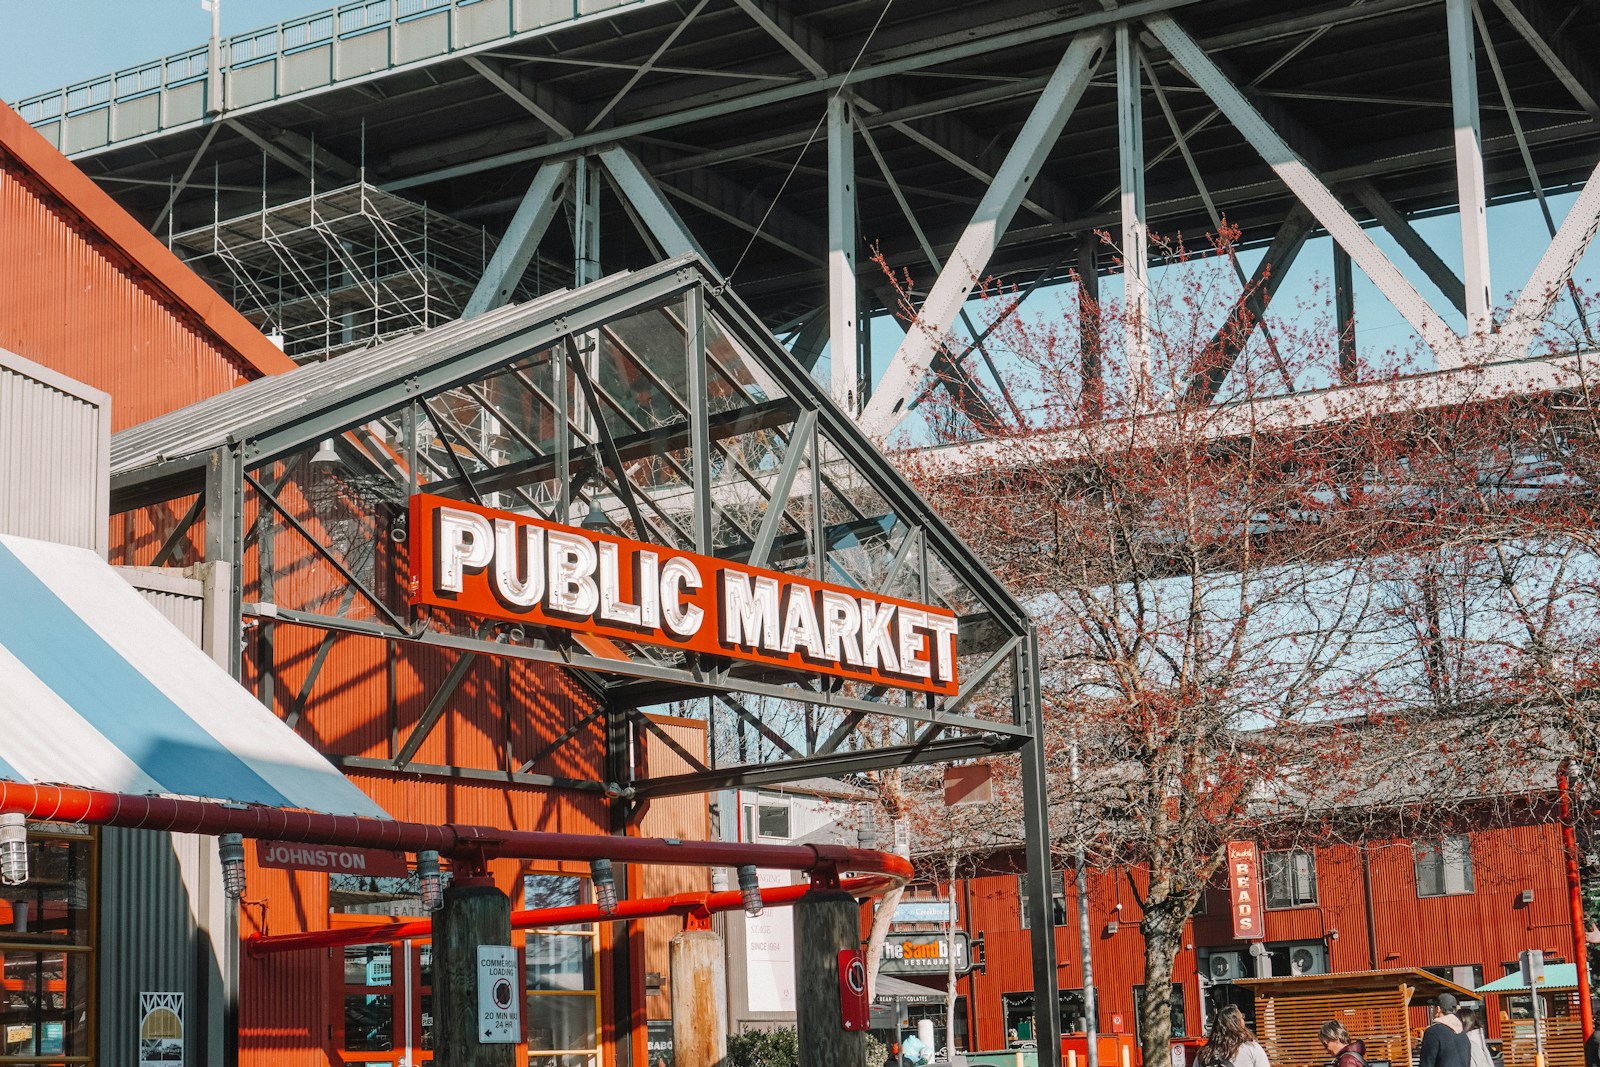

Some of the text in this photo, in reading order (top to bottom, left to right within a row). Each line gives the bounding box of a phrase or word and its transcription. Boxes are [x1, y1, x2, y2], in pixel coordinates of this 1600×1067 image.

[433, 505, 958, 683] PUBLIC MARKET
[265, 846, 366, 870] JOHNSTON
[1235, 863, 1253, 930] BEADS
[751, 942, 768, 951] SINCE
[481, 959, 517, 968] COMMERCIAL
[489, 968, 514, 977] LOADING
[484, 1011, 494, 1020] 20
[495, 1012, 508, 1020] MIN
[495, 1020, 513, 1029] 24 HR
